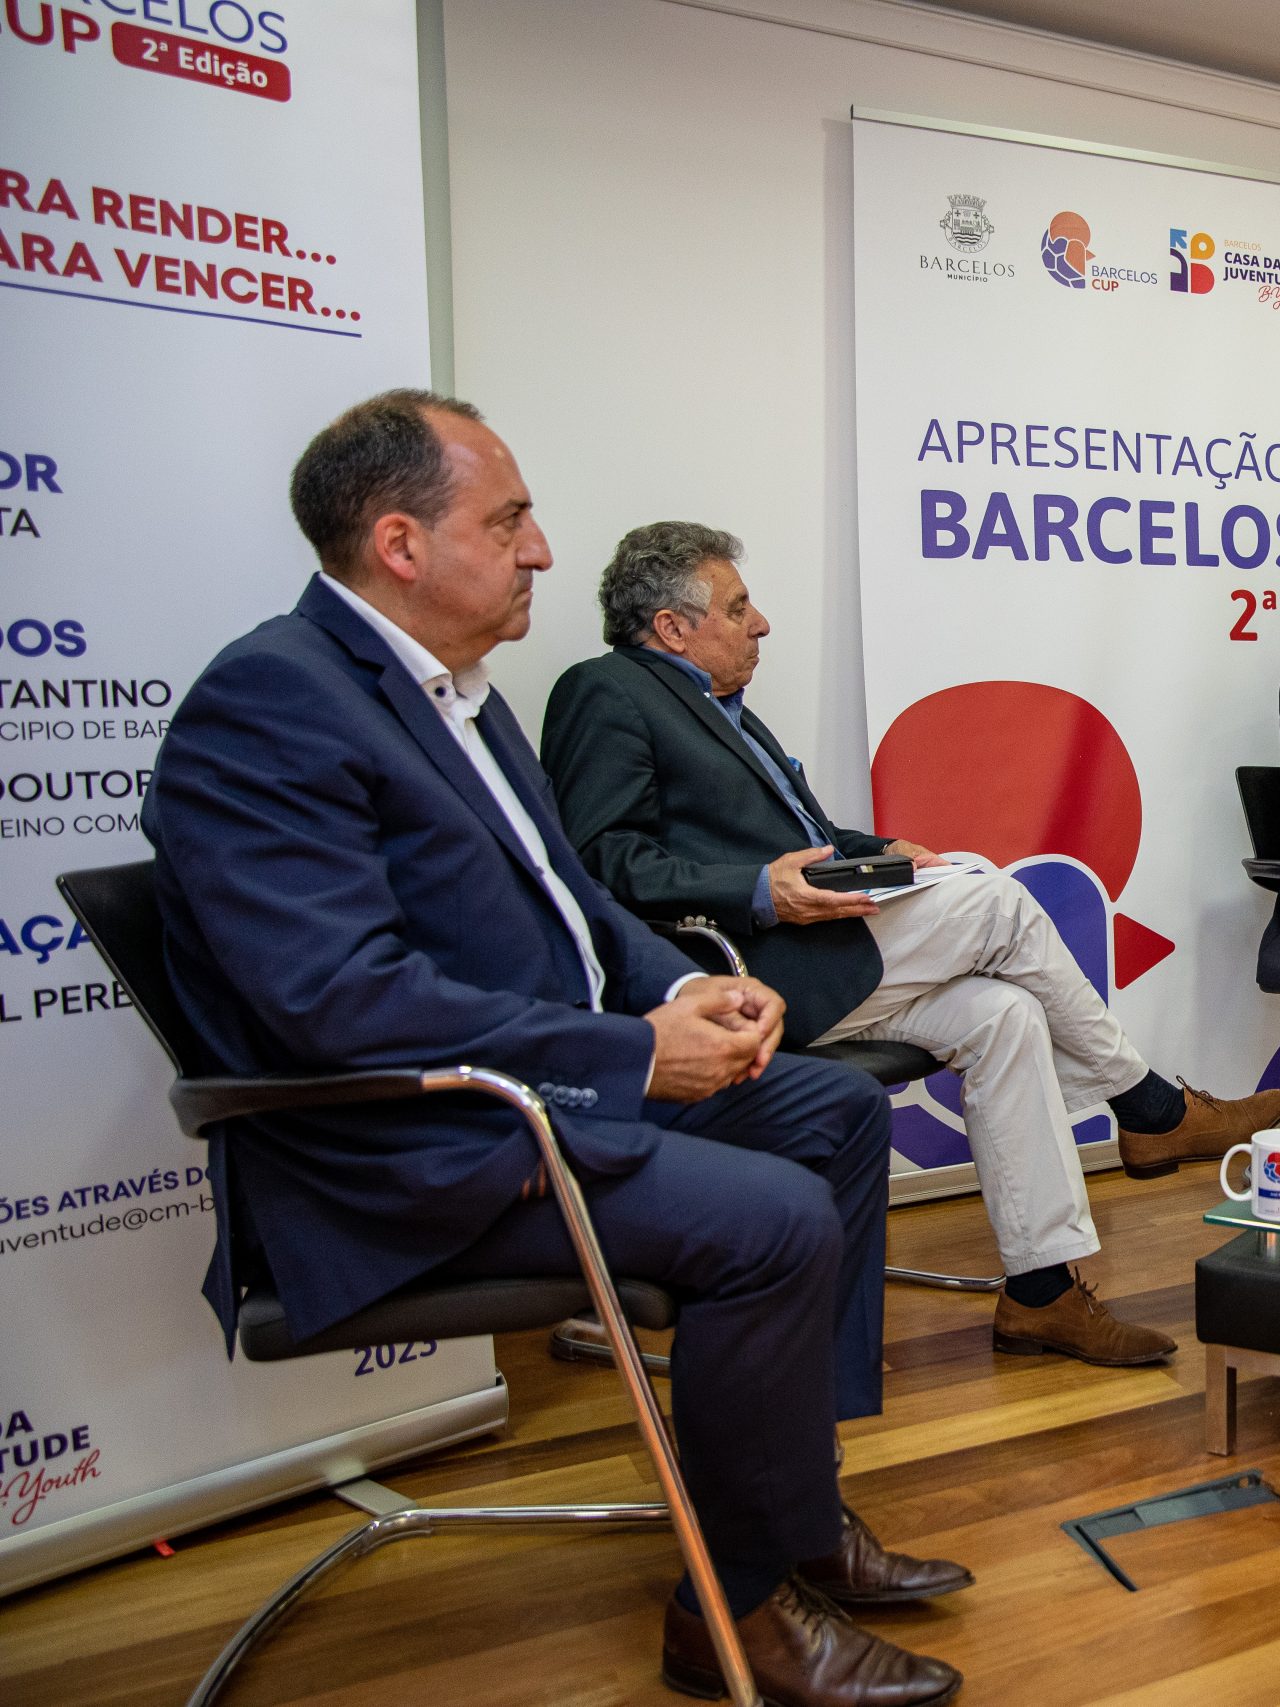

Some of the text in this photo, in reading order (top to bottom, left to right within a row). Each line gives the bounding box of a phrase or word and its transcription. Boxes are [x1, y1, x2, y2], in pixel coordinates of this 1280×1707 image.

[141, 38, 268, 88] 2ª Edição
[92, 186, 336, 266] RENDER...
[1224, 239, 1261, 252] BARCELOS
[920, 255, 1015, 278] BARCELOS
[1224, 251, 1260, 268] CASA
[113, 247, 361, 322] VENCER...
[947, 273, 988, 283] MUNICÍPIO
[1091, 265, 1158, 285] BARCELOS
[1091, 278, 1119, 291] CUP
[1229, 588, 1277, 642] 2ª
[0, 618, 87, 658] OS
[0, 720, 75, 741] CIPIO
[83, 720, 116, 740] DE
[1, 813, 139, 838] EINO COM
[57, 1167, 180, 1213] ATRAVÉS
